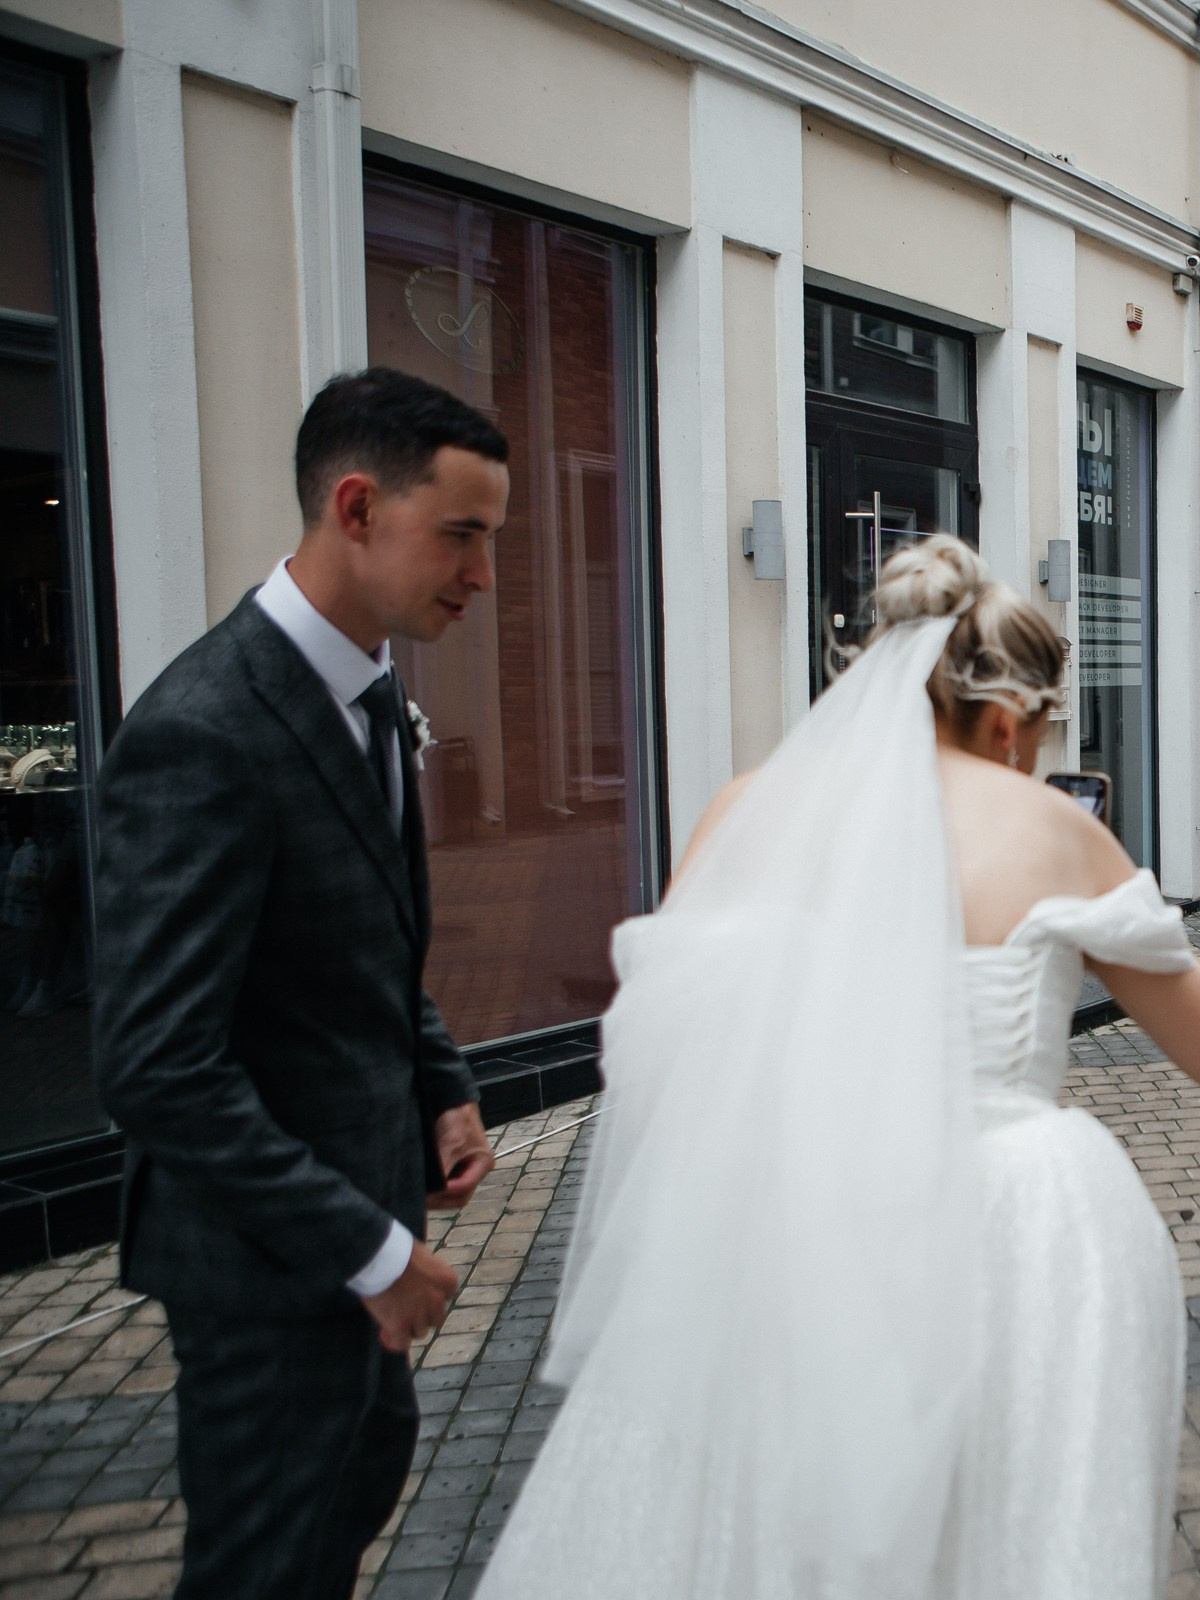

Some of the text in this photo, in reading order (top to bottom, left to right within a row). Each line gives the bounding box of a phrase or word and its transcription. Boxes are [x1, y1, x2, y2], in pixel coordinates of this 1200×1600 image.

[1077, 400, 1112, 456] Ы
[1078, 491, 1112, 525] БЯ!
[1079, 578, 1107, 588] ESIGNER
[1079, 602, 1129, 613] ACK DEVELOPER
[1086, 627, 1118, 635] MANAGER
[1079, 649, 1117, 658] DEVELOPER
[1079, 673, 1111, 682] EVELOPER
